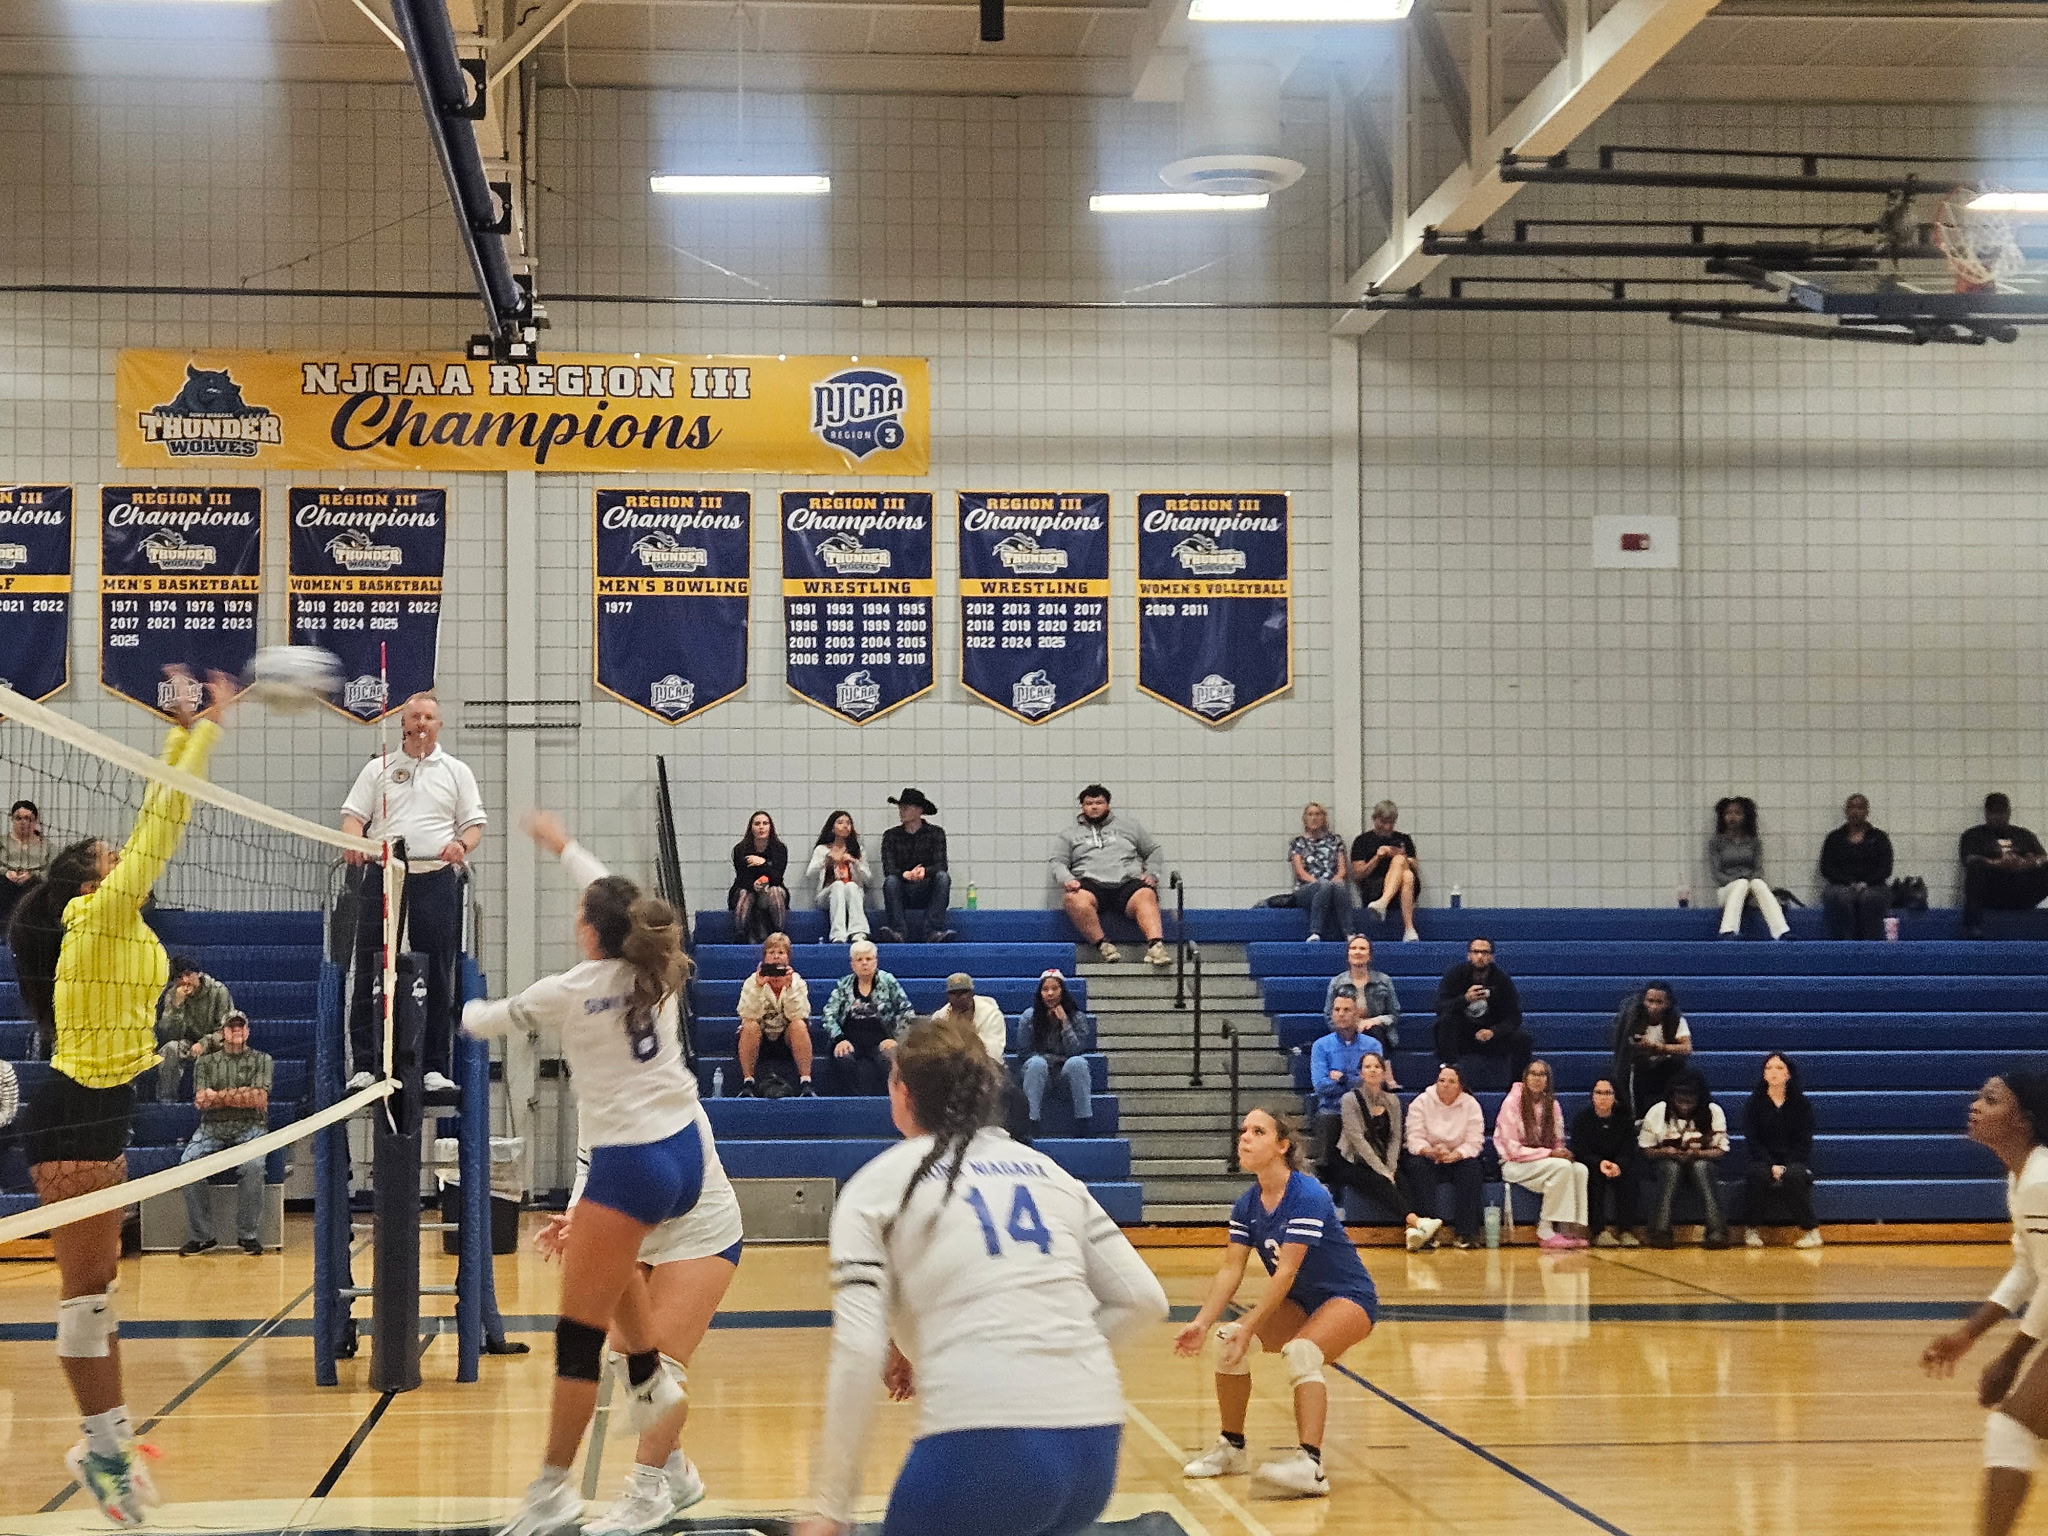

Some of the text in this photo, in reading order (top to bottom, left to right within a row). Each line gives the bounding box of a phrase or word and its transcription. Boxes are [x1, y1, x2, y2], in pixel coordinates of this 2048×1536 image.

[302, 363, 751, 399] NJCAA REGION III
[814, 385, 904, 428] NJCAA
[141, 413, 281, 443] THUNDER
[331, 391, 722, 464] Champions
[830, 430, 871, 440] REGION
[884, 428, 897, 443] 3
[169, 440, 257, 456] WOLVES
[21, 492, 43, 504] III
[131, 493, 231, 505] REGION III
[318, 494, 417, 507] REGION III
[625, 496, 722, 508] REGION III
[809, 498, 906, 510] REGION III
[986, 498, 1082, 511] REGION III
[1165, 499, 1260, 512] REGION III
[108, 503, 254, 531] Champions
[296, 504, 439, 533] Champions
[602, 505, 744, 534] Champions
[787, 508, 927, 536] Champions
[964, 508, 1103, 536] Champions
[1143, 509, 1282, 538] Champions
[150, 547, 215, 560] THUNDER
[336, 549, 401, 562] THUNDER
[642, 550, 705, 563] THUNDER
[103, 579, 259, 591] MEN'S BASKETBALL
[290, 578, 443, 592] WOMEN'S BASKETBALL
[600, 579, 748, 593] MEN'S BOWLING
[804, 581, 912, 594] WRESTLING
[981, 581, 1089, 594] WRESTLING
[1140, 583, 1287, 595] WOMEN'S VOLLEYBALL
[32, 600, 64, 612] 2022
[111, 600, 253, 612] 1971 1974 1978 1979
[333, 600, 365, 613] 2020
[370, 600, 400, 613] 2021
[407, 601, 439, 614] 2022
[604, 602, 633, 614] 1977
[789, 603, 926, 616] 1991 1993 1994 1995
[966, 603, 1102, 616] 2012 2013 2014 2017
[1181, 604, 1209, 616] 2011
[110, 617, 253, 630] 2017 2021 2022 2023
[296, 617, 399, 630] 2023 2024 2025
[896, 620, 927, 632] 2000
[1037, 620, 1068, 632] 2020
[1073, 620, 1102, 632] 2021
[109, 634, 140, 647] 2025
[789, 636, 927, 649] 2001 2003 2004 2005
[966, 636, 1066, 649] 2022 2024 2025
[825, 652, 855, 665] 2007
[897, 652, 926, 665] 2010
[968, 1160, 1052, 1180] NIAGARA
[963, 1183, 1053, 1257] 14
